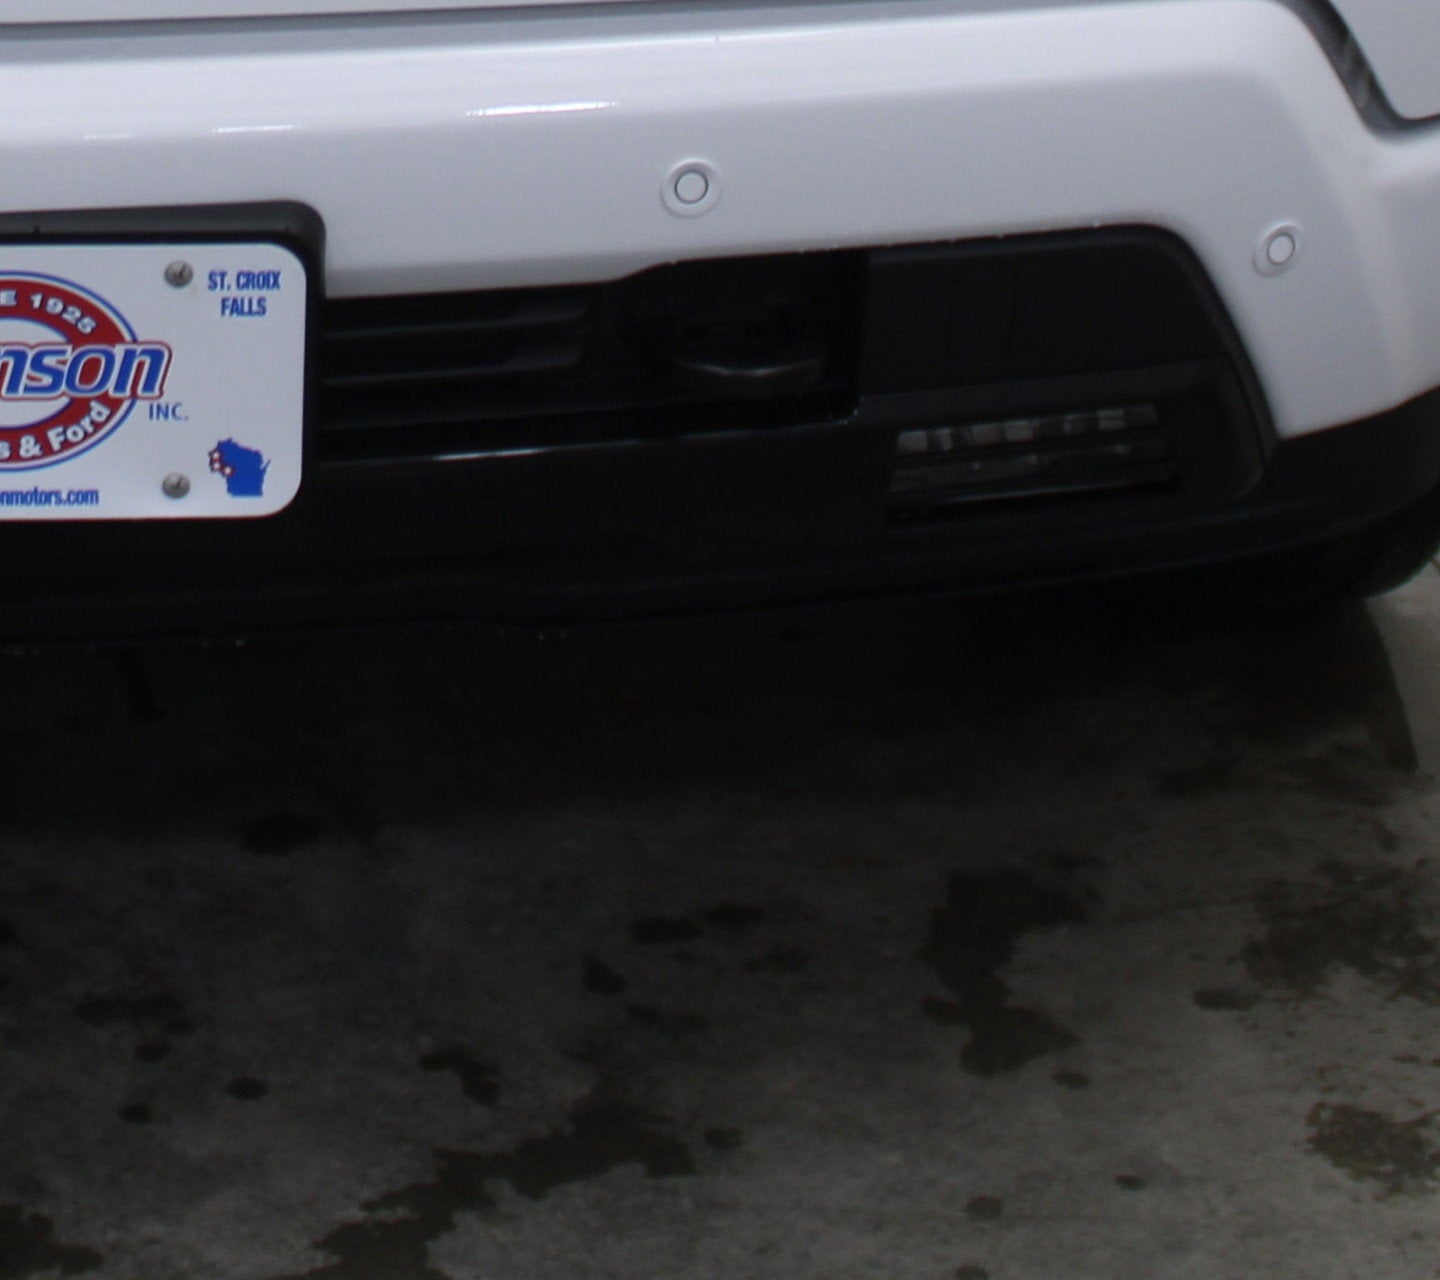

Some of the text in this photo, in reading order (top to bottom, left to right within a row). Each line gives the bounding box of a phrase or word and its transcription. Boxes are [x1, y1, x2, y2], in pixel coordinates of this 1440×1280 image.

[208, 269, 281, 291] ST. CROIX
[30, 292, 98, 335] 1925
[221, 295, 267, 316] FALLS
[148, 402, 189, 422] INC.
[19, 433, 43, 458] &
[47, 401, 112, 452] Ford
